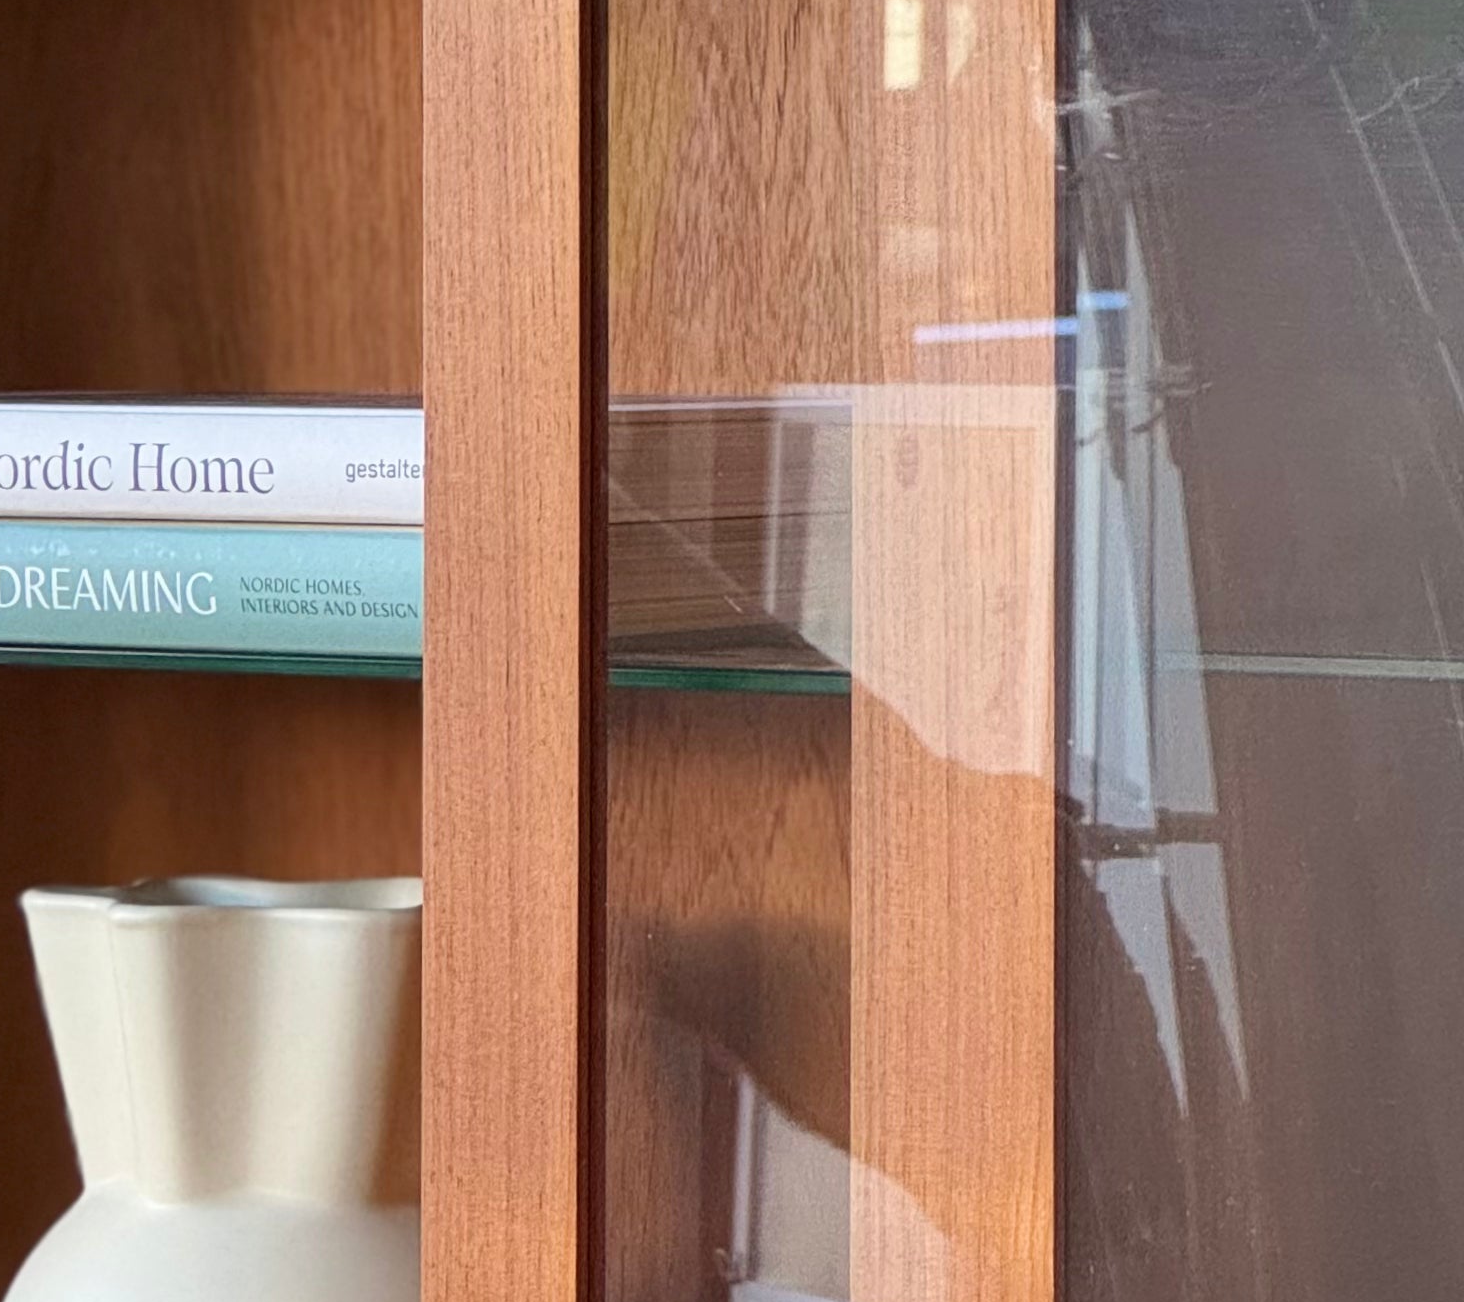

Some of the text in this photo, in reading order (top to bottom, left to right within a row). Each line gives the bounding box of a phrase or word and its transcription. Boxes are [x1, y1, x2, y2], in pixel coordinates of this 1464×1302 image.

[128, 441, 275, 495] Home
[345, 458, 424, 484] gestalte
[239, 576, 301, 595] NORDIC
[240, 597, 419, 619] INTERIORS AND DESIGN
